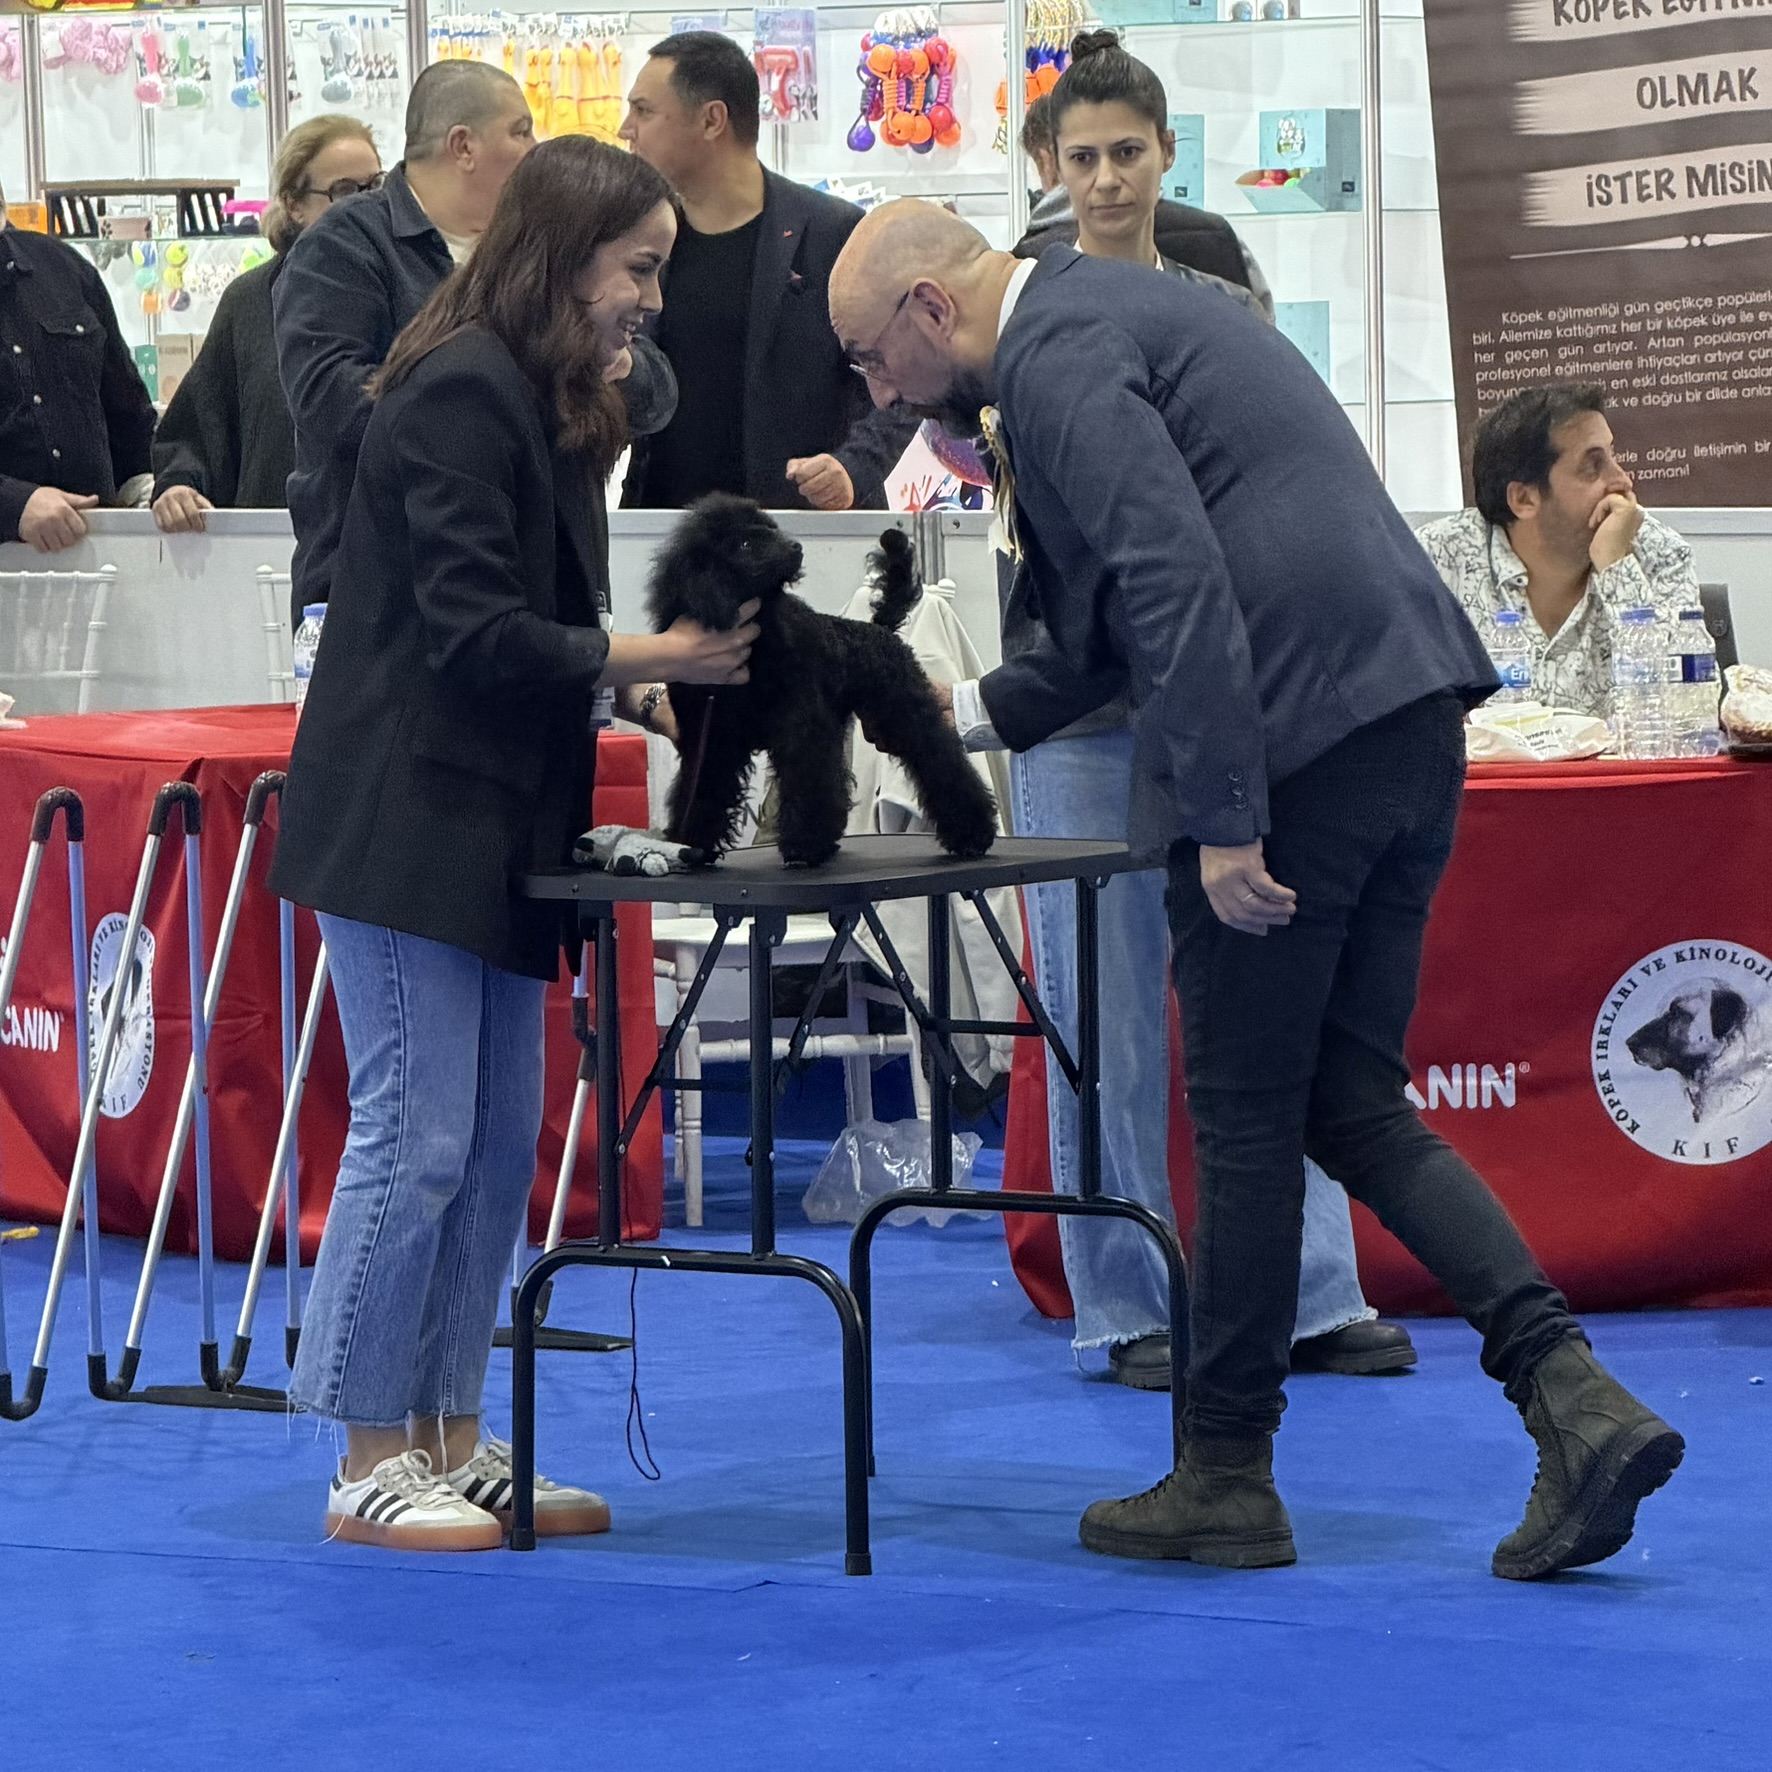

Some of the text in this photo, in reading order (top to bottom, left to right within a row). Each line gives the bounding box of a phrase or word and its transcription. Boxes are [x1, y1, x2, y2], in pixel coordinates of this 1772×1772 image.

[1636, 66, 1759, 110] OLMAK
[1502, 290, 1772, 325] Köpek eğitmenliği gün geçtikçe popülerl
[1499, 328, 1552, 343] Ailemize
[1556, 323, 1617, 339] kattığımız
[1621, 320, 1642, 333] her
[1647, 318, 1662, 331] bir
[1667, 314, 1708, 331] köpek
[1712, 312, 1736, 327] üye
[1740, 310, 1754, 323] ile
[1474, 350, 1496, 363] her
[1504, 348, 1549, 365] geçen
[1558, 345, 1584, 360] gün
[1593, 340, 1638, 355] artıyor.
[1648, 335, 1684, 350] Artan
[1475, 363, 1551, 385] profesyonel
[1555, 357, 1633, 377] eğitmenlere
[1637, 353, 1701, 371] ihtiyaçları
[1704, 350, 1744, 364] artıyor
[1611, 378, 1629, 390] en
[1660, 370, 1728, 386] dostlarımız
[1622, 397, 1639, 407] ve
[1642, 391, 1682, 407] doğru
[1685, 388, 1702, 403] bir
[1705, 386, 1738, 401] dilde
[1741, 384, 1772, 397] anla
[1646, 447, 1686, 463] doğru
[1694, 441, 1747, 459] iletişimin
[1754, 439, 1771, 453] bir
[1596, 977, 1639, 1061] IRKLARI
[1640, 958, 1666, 977] VE
